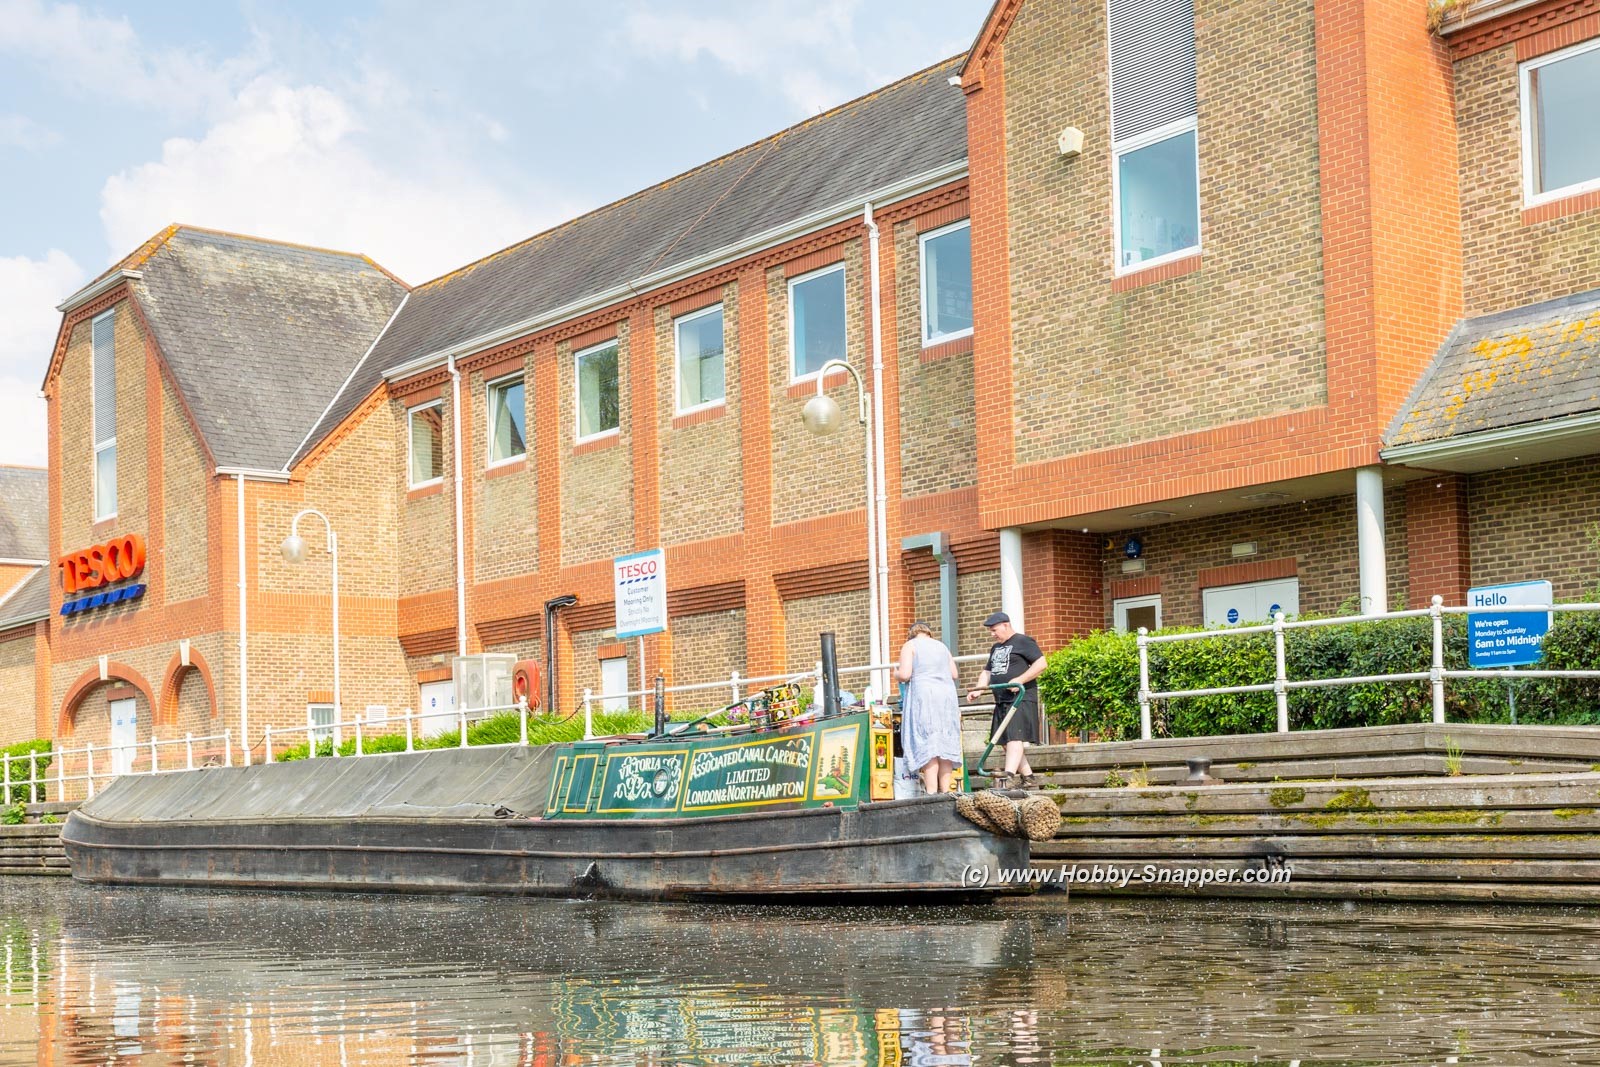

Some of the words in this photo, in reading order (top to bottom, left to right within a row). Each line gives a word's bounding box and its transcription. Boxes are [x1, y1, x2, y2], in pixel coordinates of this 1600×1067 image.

[58, 532, 147, 595] TESCO
[618, 560, 657, 579] TESCO
[1475, 593, 1507, 607] Hello
[1474, 620, 1493, 628] We're
[1493, 619, 1509, 627] open
[1475, 630, 1496, 638] Monday
[1502, 627, 1527, 635] Saturday
[1475, 639, 1494, 649] 6am
[1495, 638, 1506, 647] to
[619, 757, 661, 779] VICTORIA
[690, 750, 738, 780] ASSOCIATED
[737, 747, 768, 762] CANAL
[765, 746, 809, 768] CARRIERS
[725, 767, 771, 785] LIMITED
